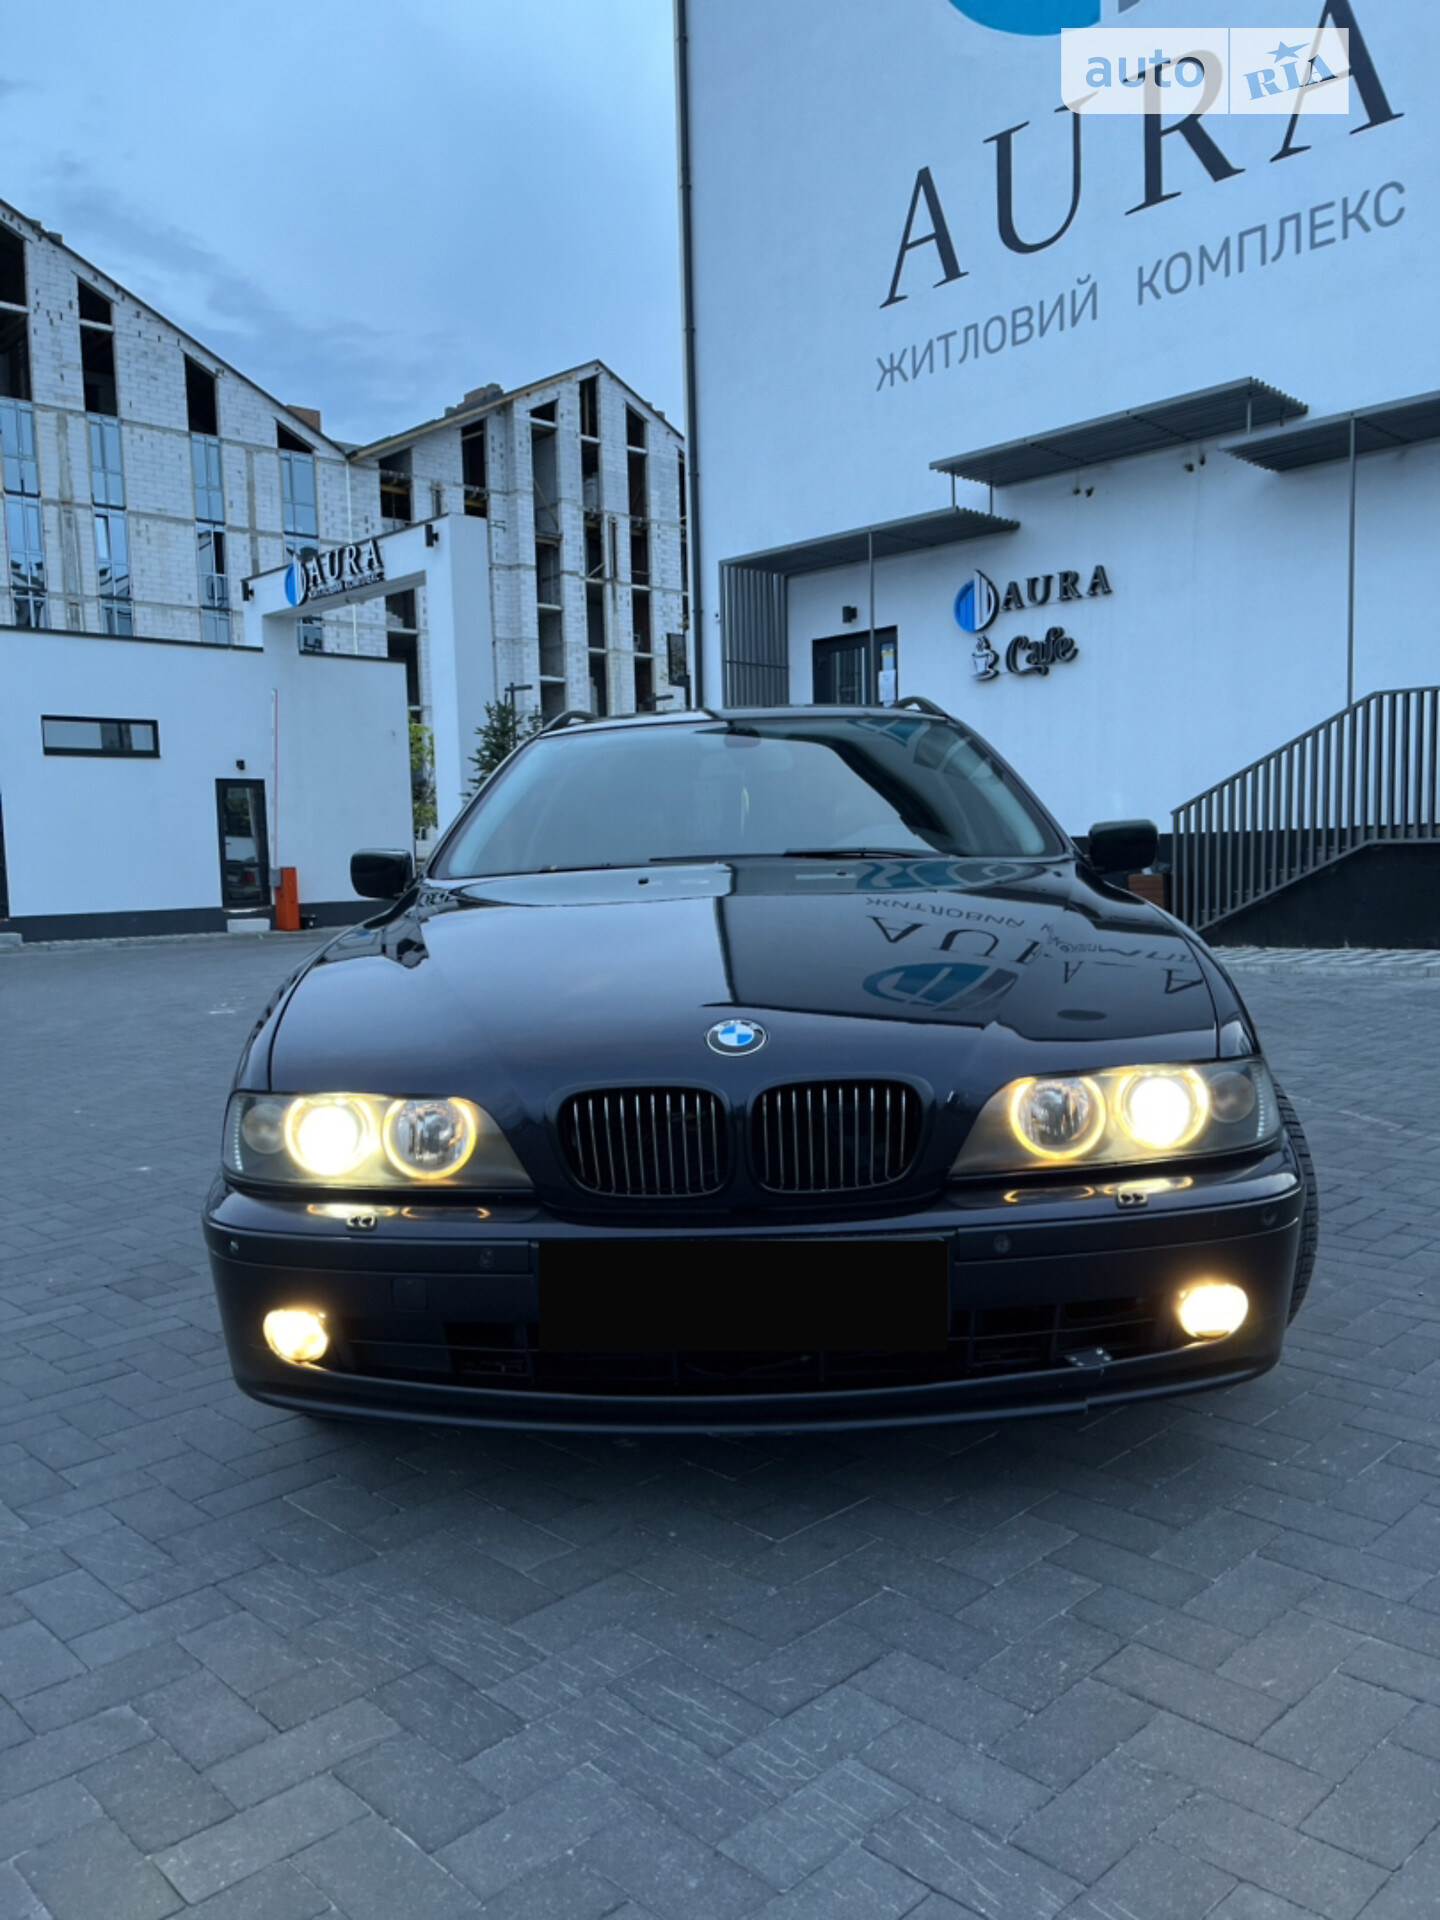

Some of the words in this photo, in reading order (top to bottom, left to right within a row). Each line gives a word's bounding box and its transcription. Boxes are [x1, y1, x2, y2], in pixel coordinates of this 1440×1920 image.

[879, 0, 1404, 308] AURA
[876, 275, 1099, 391] ЖИТЛОВИЙ
[1137, 181, 1406, 305] КОМПЛЕКС
[308, 539, 383, 587] AURA
[1002, 564, 1112, 611] AURA
[1006, 626, 1079, 676] Cafe
